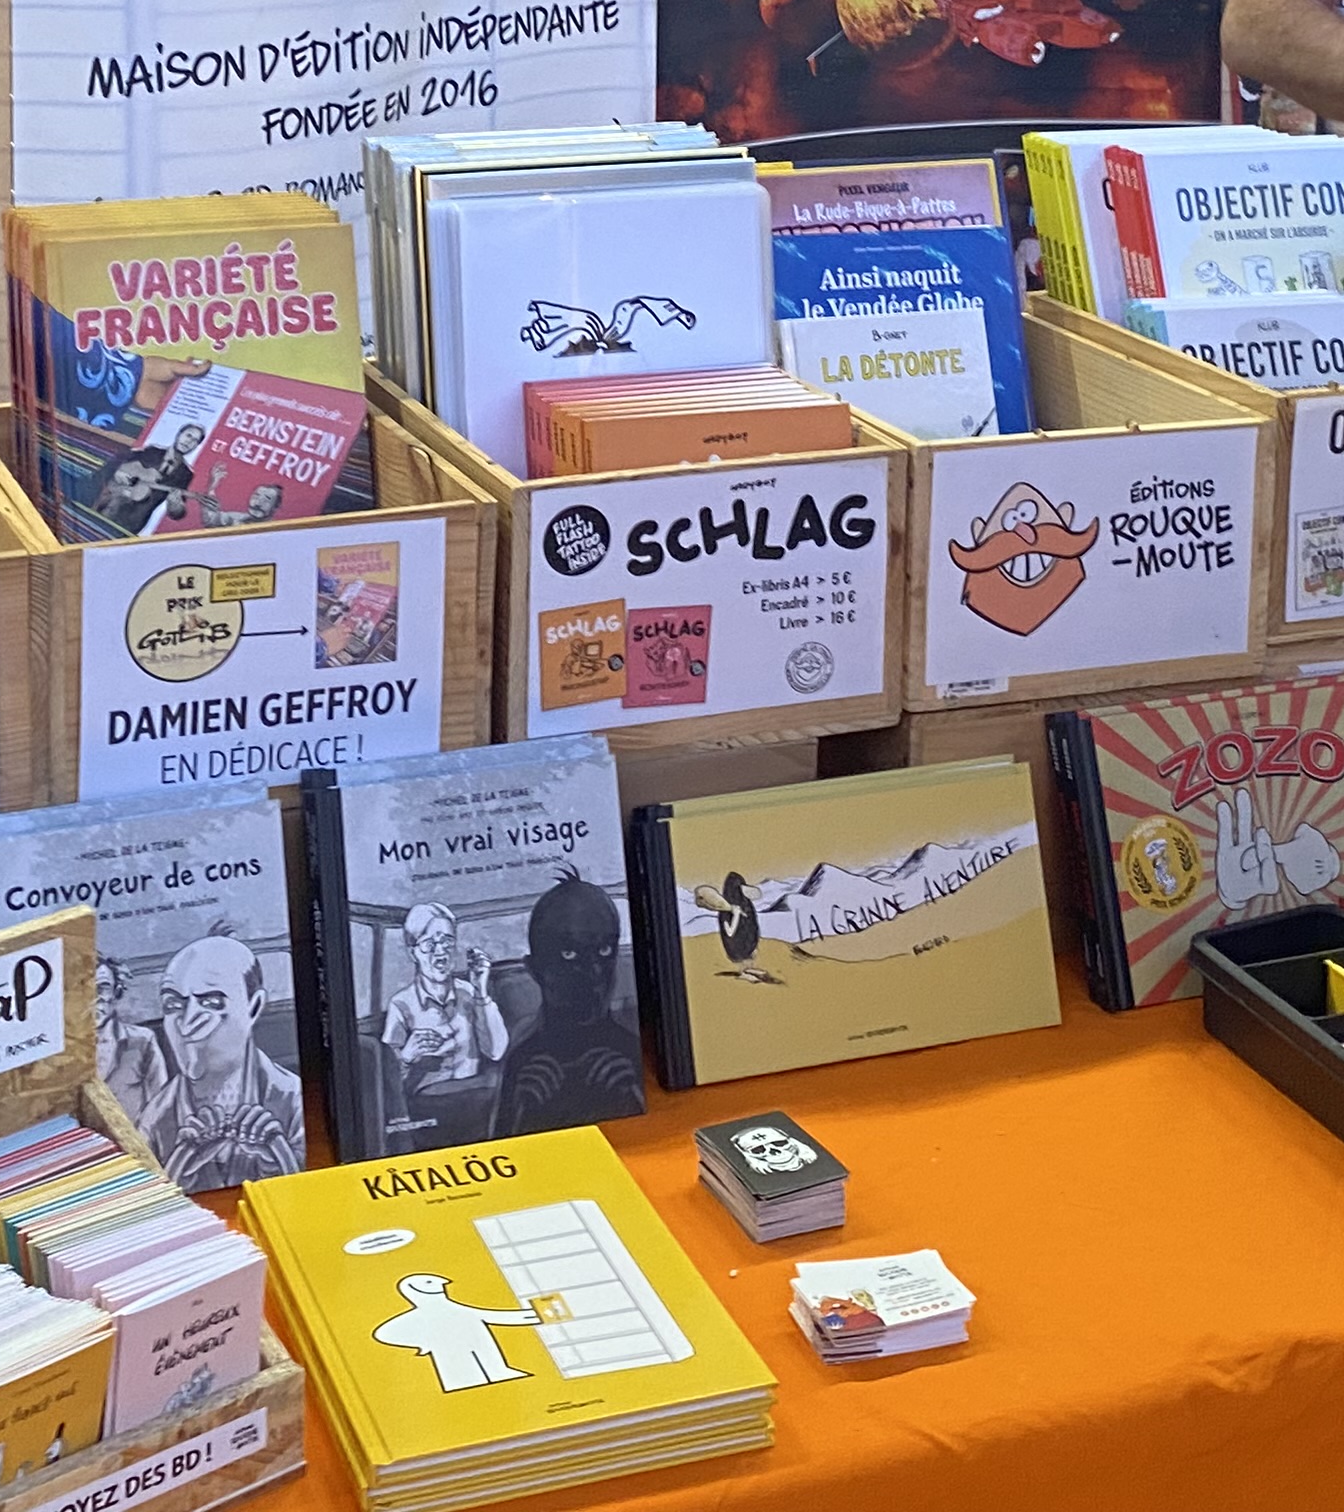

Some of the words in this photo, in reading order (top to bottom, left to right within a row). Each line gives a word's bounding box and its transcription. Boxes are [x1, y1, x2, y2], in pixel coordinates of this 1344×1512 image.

[88, 42, 246, 100] MAISON
[260, 88, 379, 146] FONDÉE
[384, 92, 413, 123] EN
[420, 69, 500, 118] 2016
[793, 203, 812, 222] La
[1175, 182, 1294, 223] OBJECTIF
[108, 238, 298, 303] VARIÉTÉ
[819, 265, 880, 291] Ainsi
[885, 261, 964, 291] naquit
[73, 291, 337, 351] FRANÇAISE
[802, 297, 825, 320] le
[827, 292, 913, 318] Vendée
[916, 290, 985, 312] Globe
[819, 354, 854, 382] LA
[860, 348, 966, 381] DÉTONTE
[224, 405, 345, 461] BERNSTEIN
[229, 435, 331, 488] GEFFROY
[553, 513, 582, 532] FULL
[557, 521, 594, 546] FLASH
[627, 494, 876, 577] SCHLAG
[1108, 504, 1234, 546] ROUQUE
[557, 533, 601, 558] TATTOO
[567, 545, 607, 571] INSIDE
[177, 575, 195, 590] LE
[742, 576, 791, 595] Ex-libris
[793, 574, 810, 590] A4
[831, 572, 841, 586] 5
[760, 594, 810, 613] Encadré
[831, 591, 846, 606] 10
[167, 595, 204, 613] PRIX
[779, 615, 809, 630] Livre
[545, 615, 622, 645] SCHLAG
[632, 619, 707, 643] SCHLAG
[108, 701, 248, 746] DAMIEN
[258, 679, 418, 731] GEFFROY
[159, 754, 199, 785] EN
[207, 736, 351, 778] DÉDICACE
[379, 840, 432, 864] Mon
[444, 826, 494, 853] vrai
[507, 819, 590, 853] visage
[5, 872, 154, 911] Convoyeur
[164, 861, 196, 889] de
[205, 857, 262, 882] cons
[796, 908, 825, 943] LA
[830, 892, 907, 935] GRANDE
[923, 837, 1023, 905] AVENTURE
[363, 1154, 518, 1201] KÅTALÖG
[124, 1464, 166, 1499] DES
[171, 1450, 201, 1478] BD
